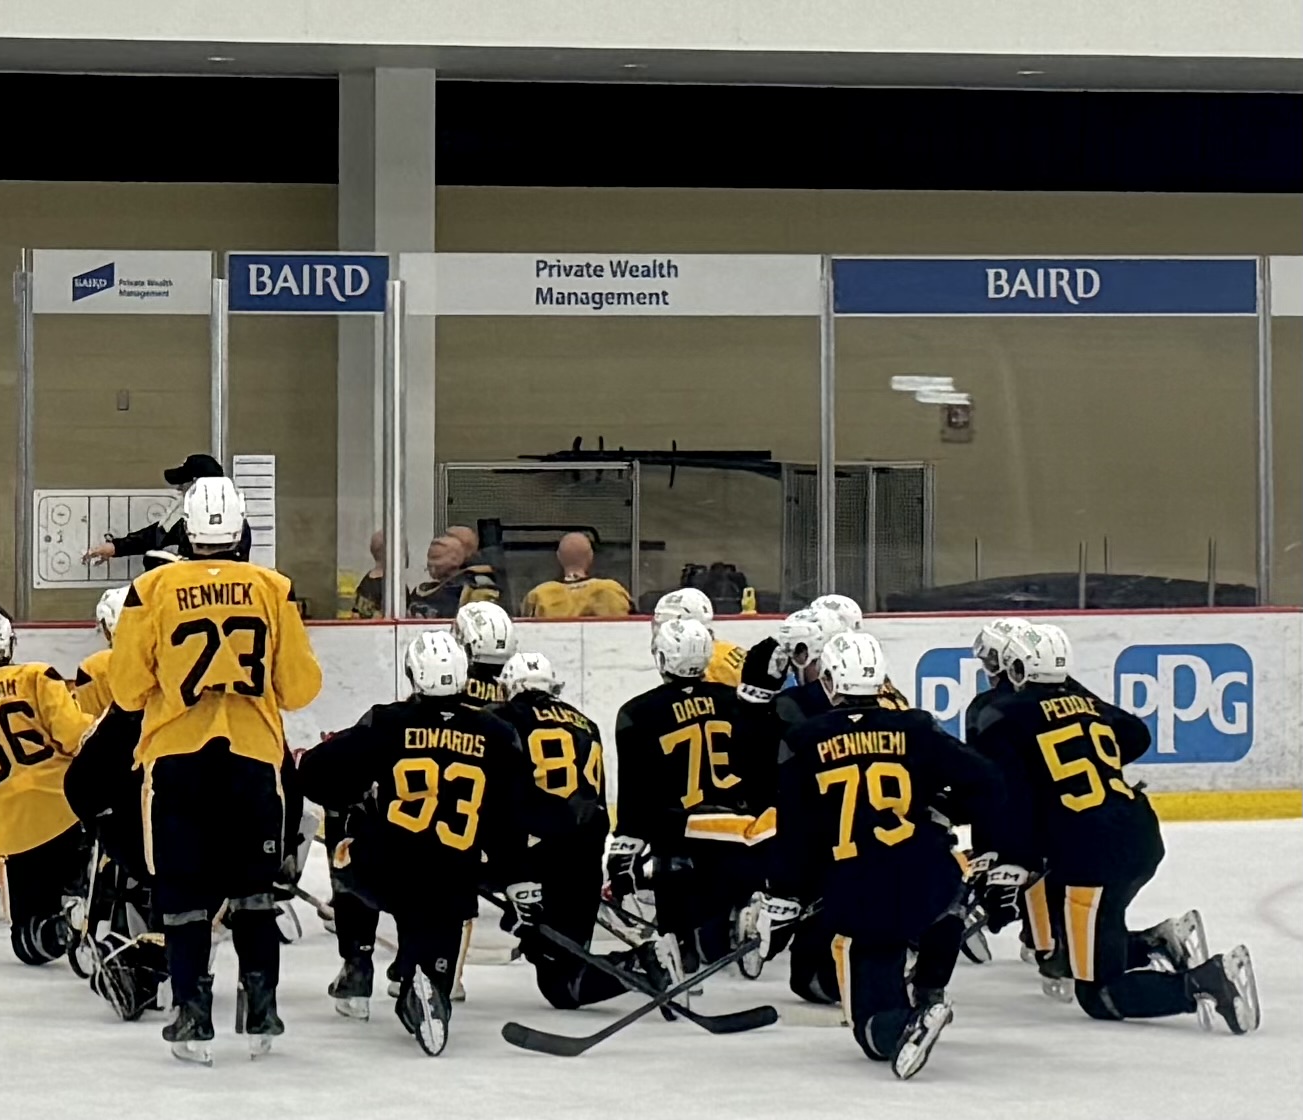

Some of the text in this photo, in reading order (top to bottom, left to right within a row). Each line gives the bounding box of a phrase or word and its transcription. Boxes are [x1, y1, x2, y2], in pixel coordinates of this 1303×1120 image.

[75, 278, 108, 290] BAIRD
[119, 278, 145, 287] Private
[248, 264, 370, 302] BAIRD
[536, 259, 678, 278] Private Wealth
[118, 289, 169, 299] Management
[535, 287, 669, 310] Management
[985, 268, 1101, 305] BAIRD
[176, 582, 254, 611] RENWICK
[171, 616, 267, 707] 23
[671, 696, 716, 724] DACH
[1119, 654, 1249, 754] PPG
[405, 727, 486, 757] EDWARDS
[817, 731, 906, 763] PIENINIEMI
[1036, 721, 1136, 813] 59
[387, 757, 486, 851] 93
[814, 761, 916, 861] 79
